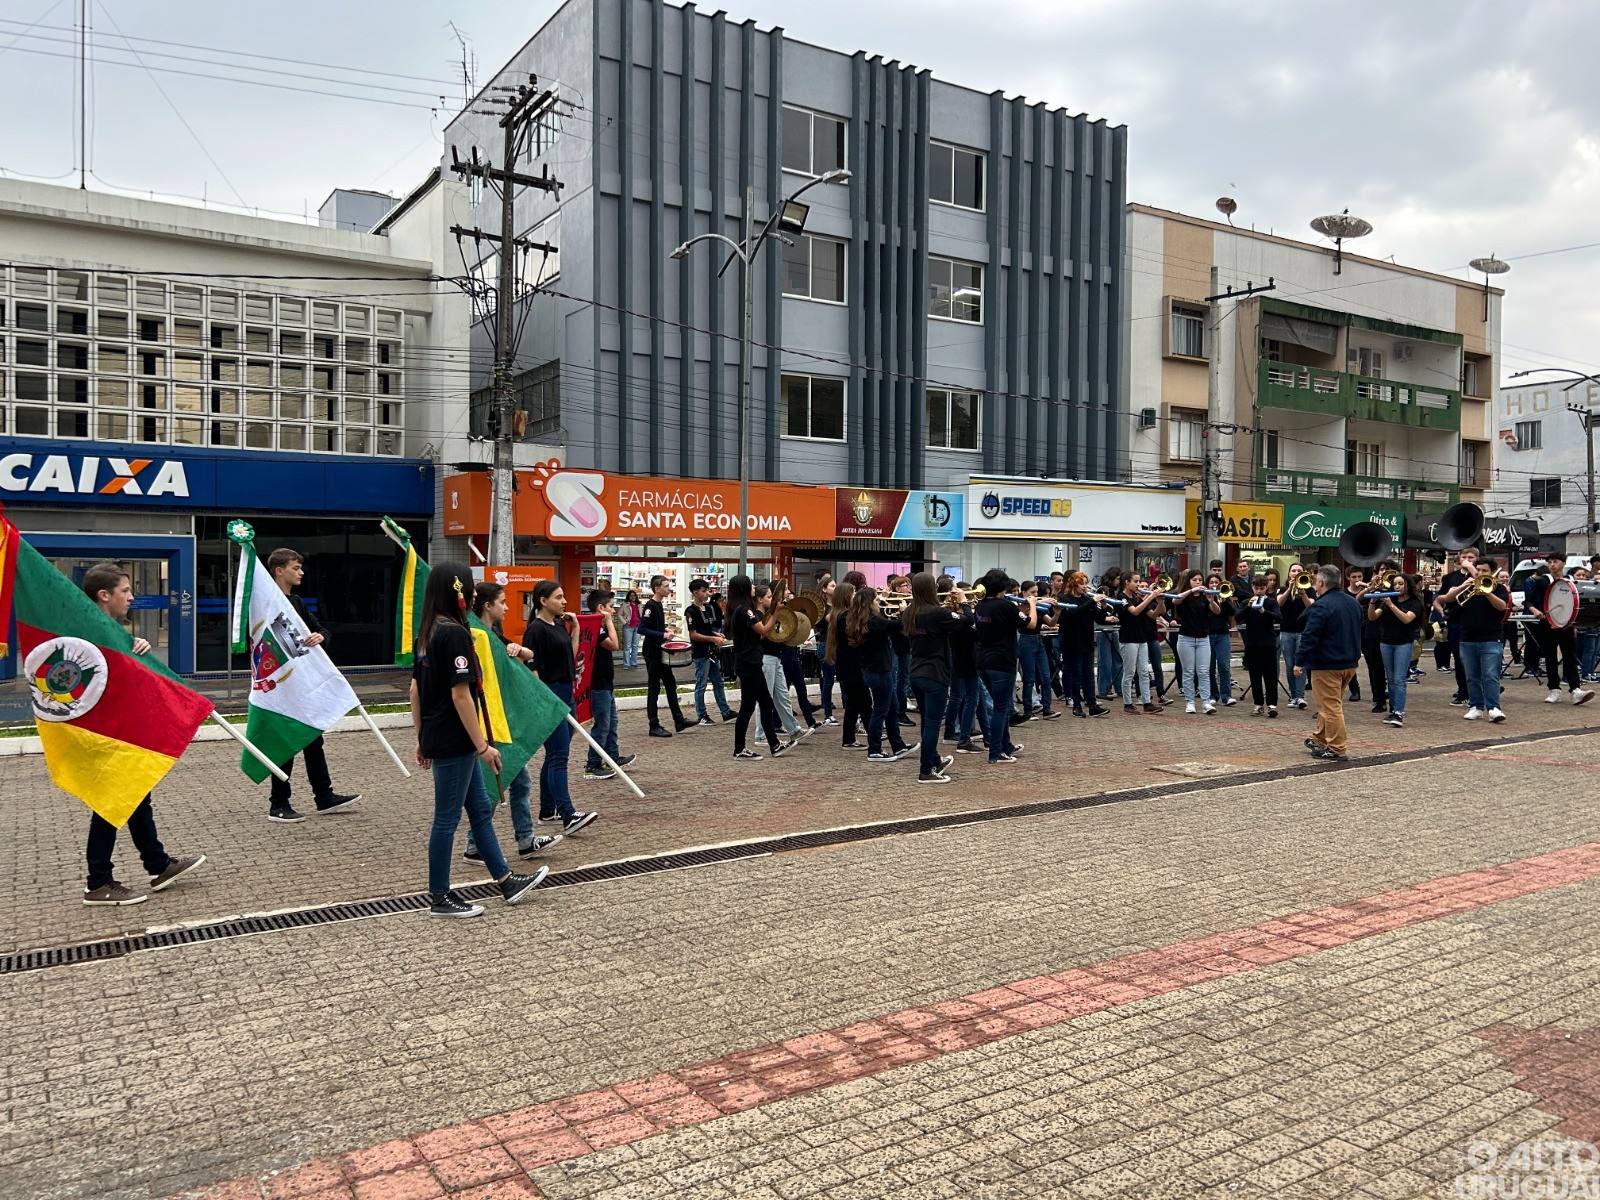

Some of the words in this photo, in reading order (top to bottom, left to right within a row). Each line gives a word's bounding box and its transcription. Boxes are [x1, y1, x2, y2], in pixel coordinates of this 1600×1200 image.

[0, 453, 190, 497] CAIXA
[619, 488, 724, 511] FARMÁCIAS
[618, 511, 687, 530] SANTA
[694, 513, 792, 531] ECONOMIA
